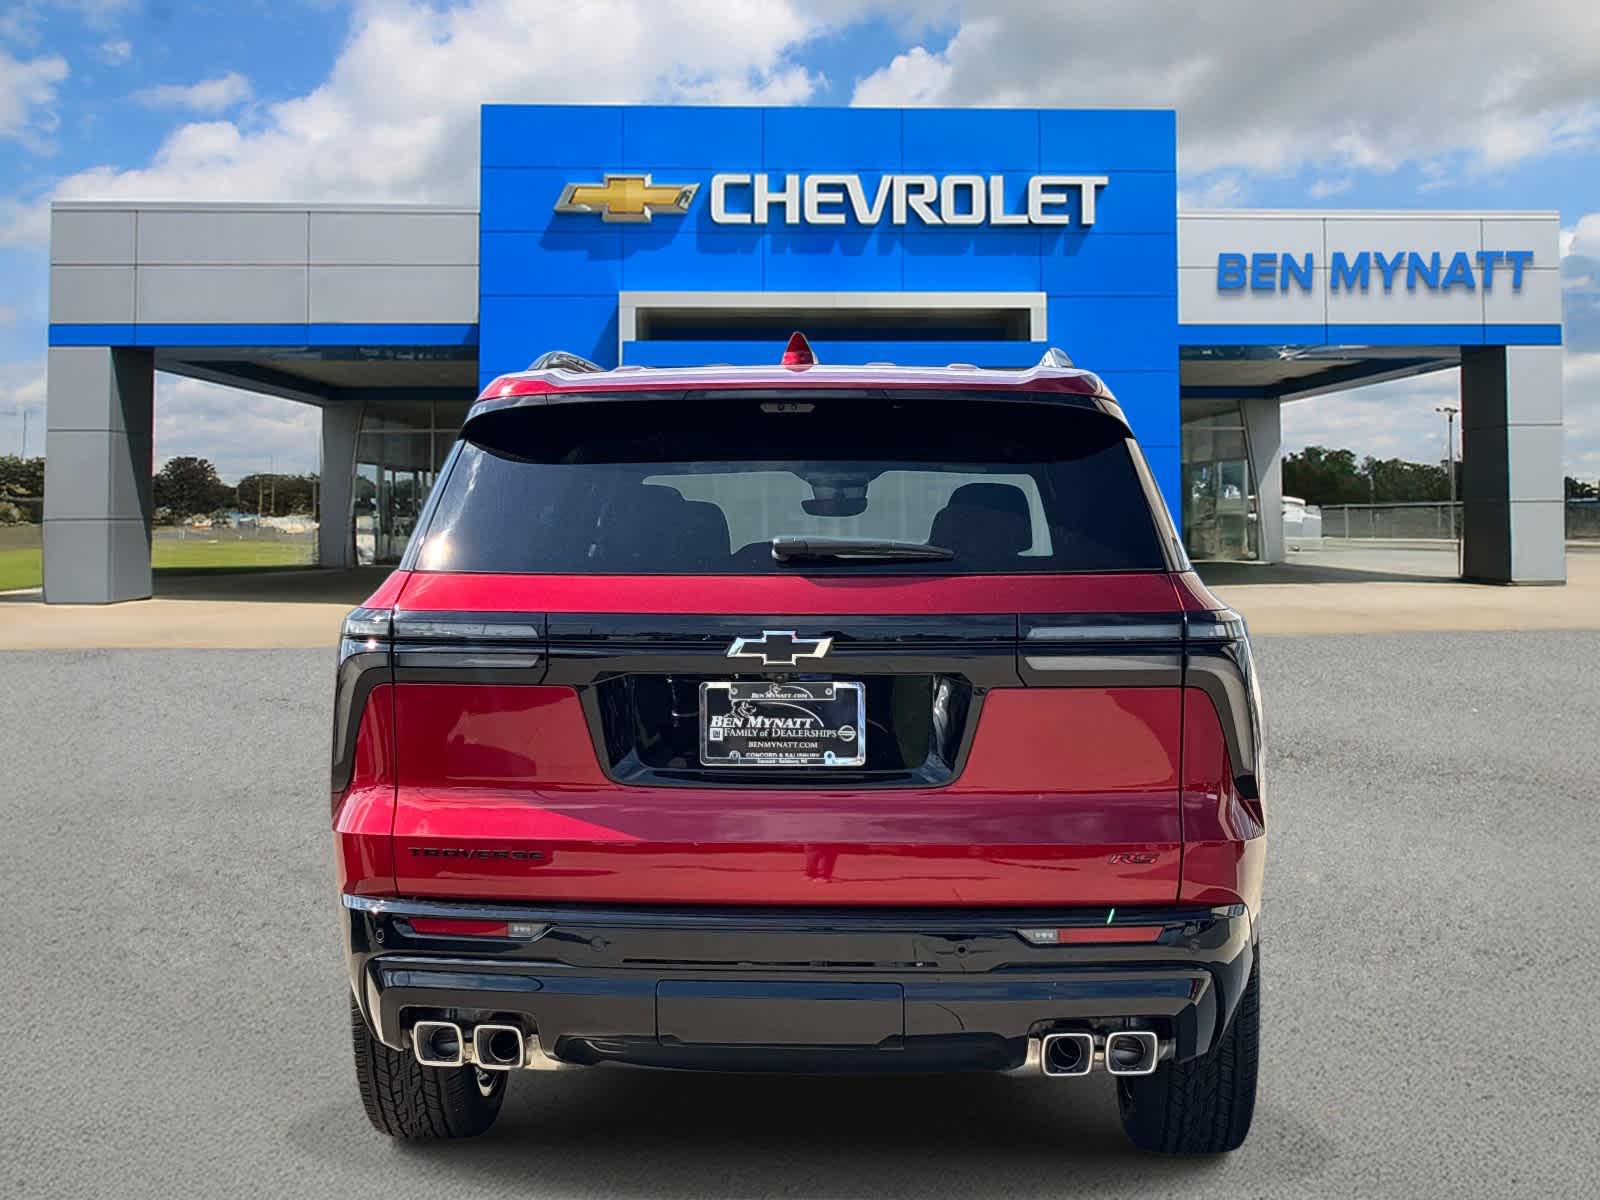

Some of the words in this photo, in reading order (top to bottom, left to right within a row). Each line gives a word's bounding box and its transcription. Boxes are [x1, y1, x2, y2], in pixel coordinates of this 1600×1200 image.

[710, 173, 1109, 226] CHEVROLET
[1217, 252, 1313, 291] BEN
[1330, 250, 1534, 291] MYNATT
[710, 715, 743, 728] BEN
[746, 716, 814, 728] MYNATT
[724, 727, 758, 737] FAMILY
[760, 727, 769, 737] of
[772, 728, 837, 738] DEALERSHIPS
